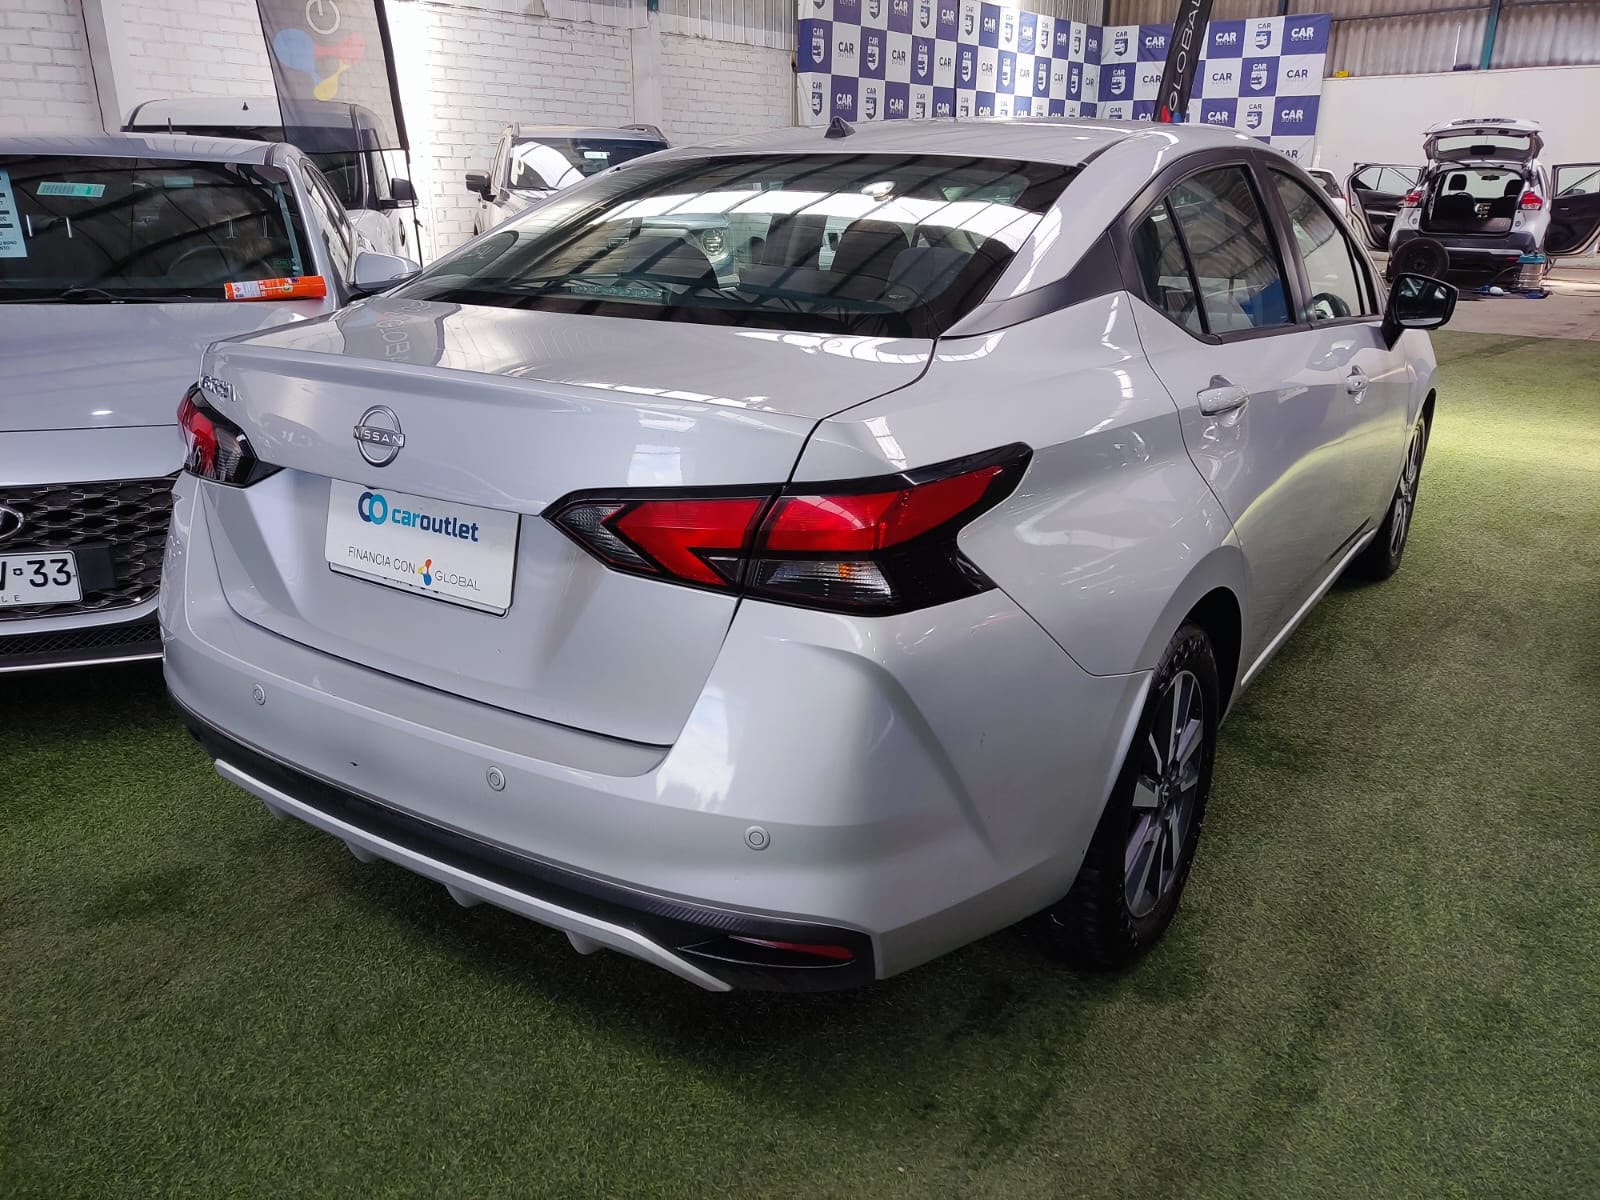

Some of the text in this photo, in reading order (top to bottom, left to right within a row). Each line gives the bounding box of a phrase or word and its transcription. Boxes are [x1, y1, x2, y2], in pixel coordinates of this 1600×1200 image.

[941, 9, 955, 21] CAR
[983, 18, 996, 29] CAR
[812, 27, 823, 36] CAR
[1291, 27, 1314, 38] CAR
[1145, 36, 1165, 46] CAR
[1215, 32, 1237, 43] CAR
[838, 41, 854, 53] CAR
[891, 50, 906, 61] CAR
[939, 57, 952, 68] CAR
[981, 63, 993, 73] CAR
[1252, 63, 1267, 71] CAR
[1142, 74, 1161, 84] CAR
[1212, 72, 1232, 82] CAR
[1286, 70, 1308, 79] CAR
[866, 87, 876, 95] CAR
[836, 93, 852, 107] CAR
[889, 98, 904, 110] CAR
[936, 103, 950, 114] CAR
[1207, 111, 1229, 122] CAR
[1281, 109, 1304, 120] CAR
[354, 427, 402, 446] NISSAN
[391, 507, 479, 542] caroutlet
[348, 546, 481, 591] FINANCIA CON GLOBAL
